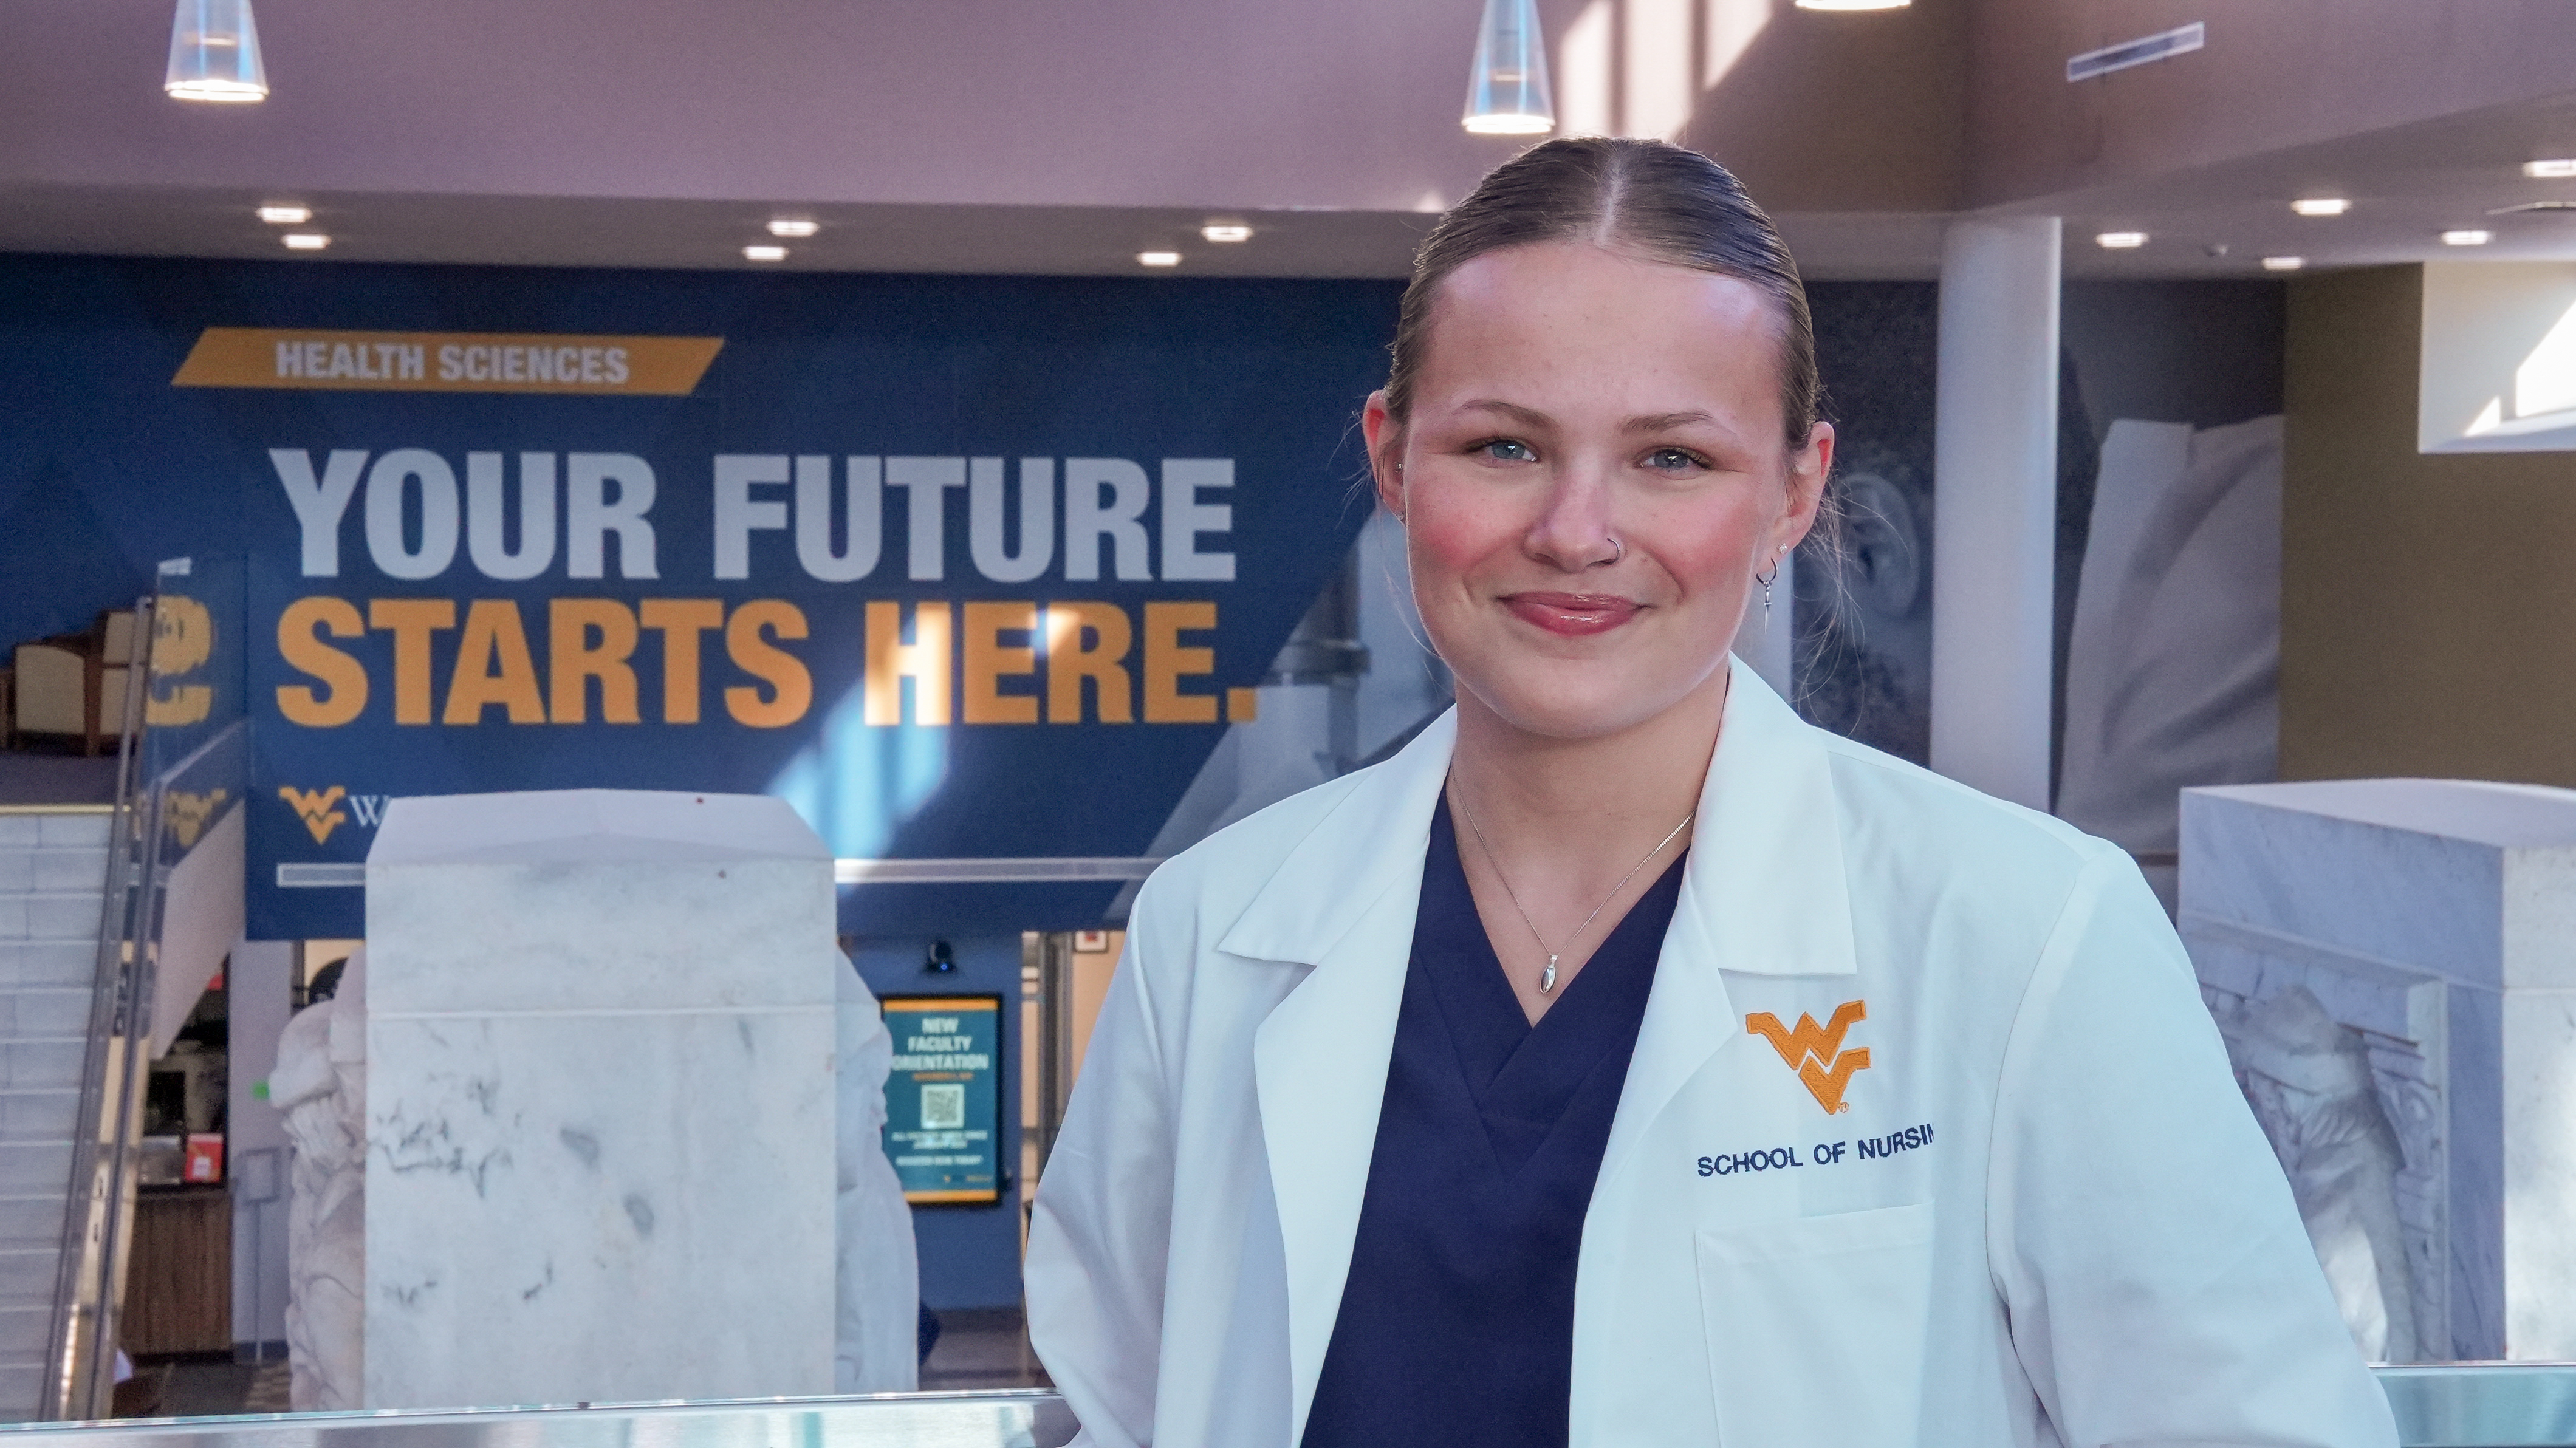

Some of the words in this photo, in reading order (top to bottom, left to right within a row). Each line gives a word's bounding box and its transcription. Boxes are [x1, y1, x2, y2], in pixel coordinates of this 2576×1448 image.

[275, 341, 425, 379] HEALTH
[438, 344, 629, 384] SCIENCES
[268, 448, 660, 580] YOUR
[713, 454, 1236, 582] FUTURE
[276, 596, 812, 726] STARTS
[863, 600, 1257, 726] HERE.
[908, 1036, 972, 1052] FACULTY
[922, 1018, 959, 1033] NEW
[1697, 1147, 1804, 1177] SCHOOL
[1814, 1141, 1846, 1165] OF
